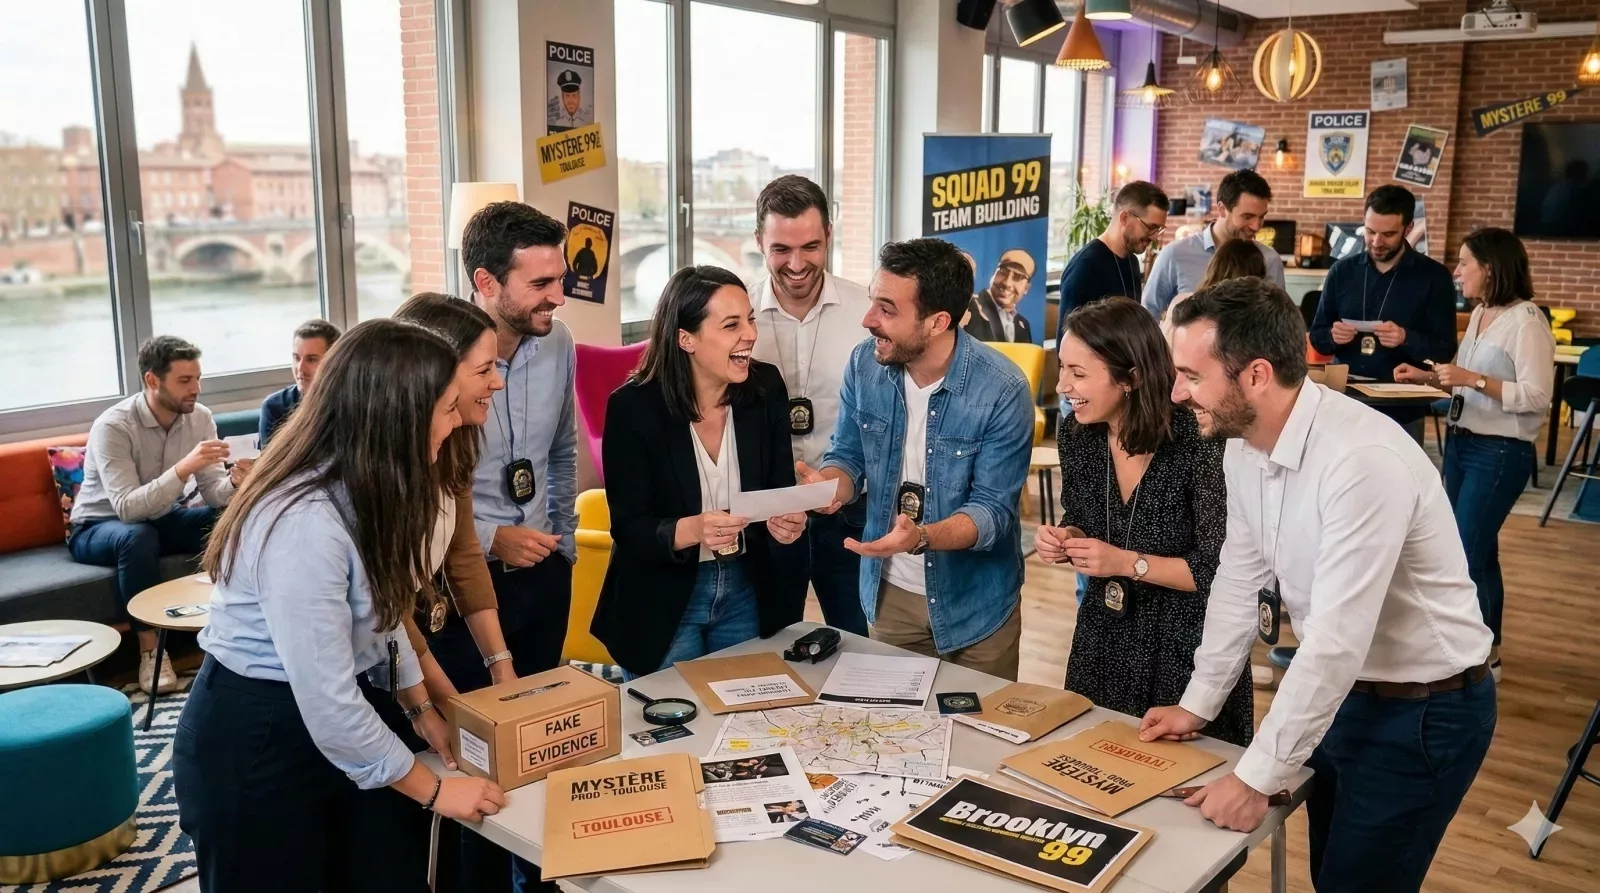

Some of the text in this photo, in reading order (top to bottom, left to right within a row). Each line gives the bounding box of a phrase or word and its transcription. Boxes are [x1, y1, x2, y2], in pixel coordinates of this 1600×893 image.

[549, 45, 592, 64] POLICE
[1546, 90, 1567, 106] 99
[1314, 115, 1363, 127] POLICE
[932, 161, 1041, 208] SQUAD 99
[571, 205, 612, 227] POLICE
[932, 195, 1040, 231] TEAM BUILDING
[545, 713, 581, 736] FAKE
[529, 732, 598, 766] EVIDENCE
[571, 770, 667, 794] MYSTÈRE
[571, 790, 601, 801] PROD
[611, 782, 668, 795] TOULOUSE
[1107, 774, 1135, 788] PROD
[580, 811, 665, 834] TOULOUSE
[945, 800, 1107, 850] Brooklyn
[1038, 842, 1093, 866] 99
